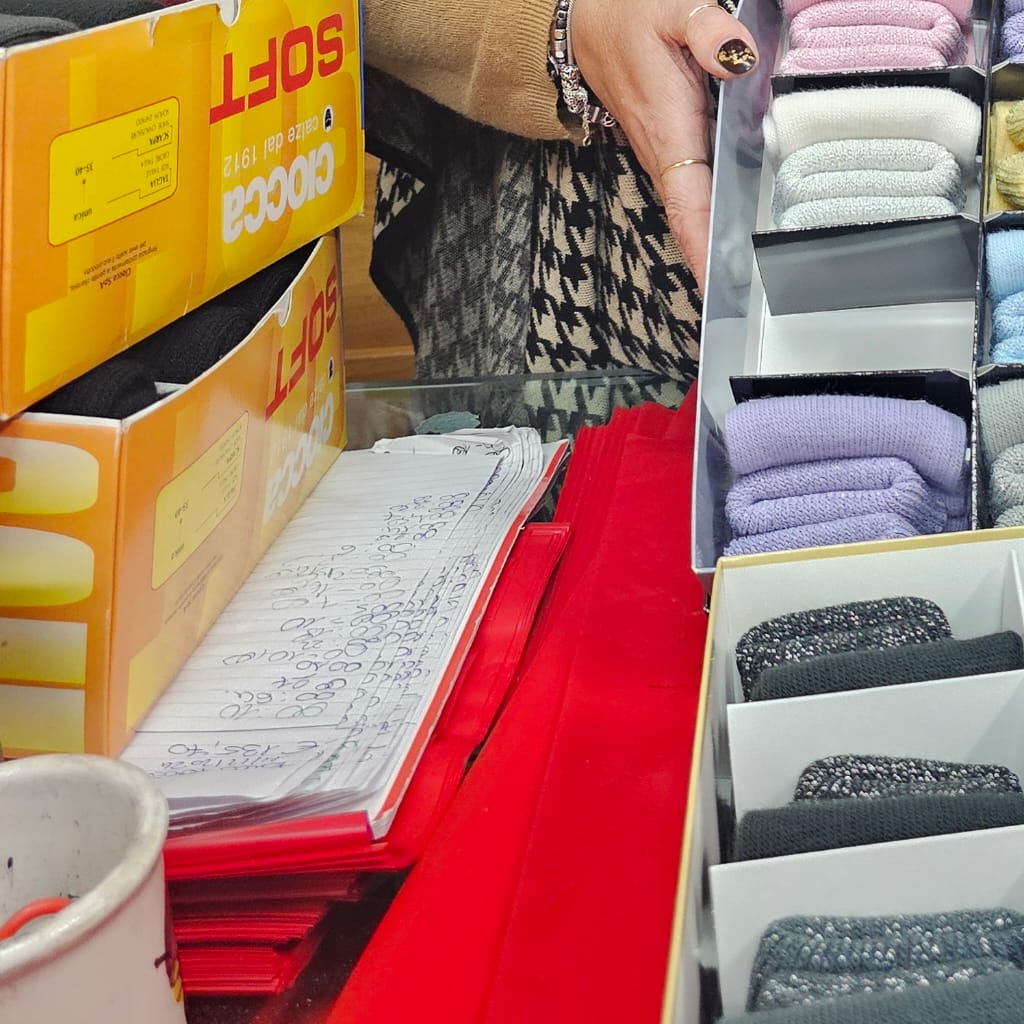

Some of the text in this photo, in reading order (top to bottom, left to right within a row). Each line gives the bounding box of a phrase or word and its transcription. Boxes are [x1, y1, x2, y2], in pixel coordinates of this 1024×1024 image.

[209, 12, 343, 125] SOFT
[223, 115, 319, 178] calze dal 1912
[265, 263, 338, 424] SOFT
